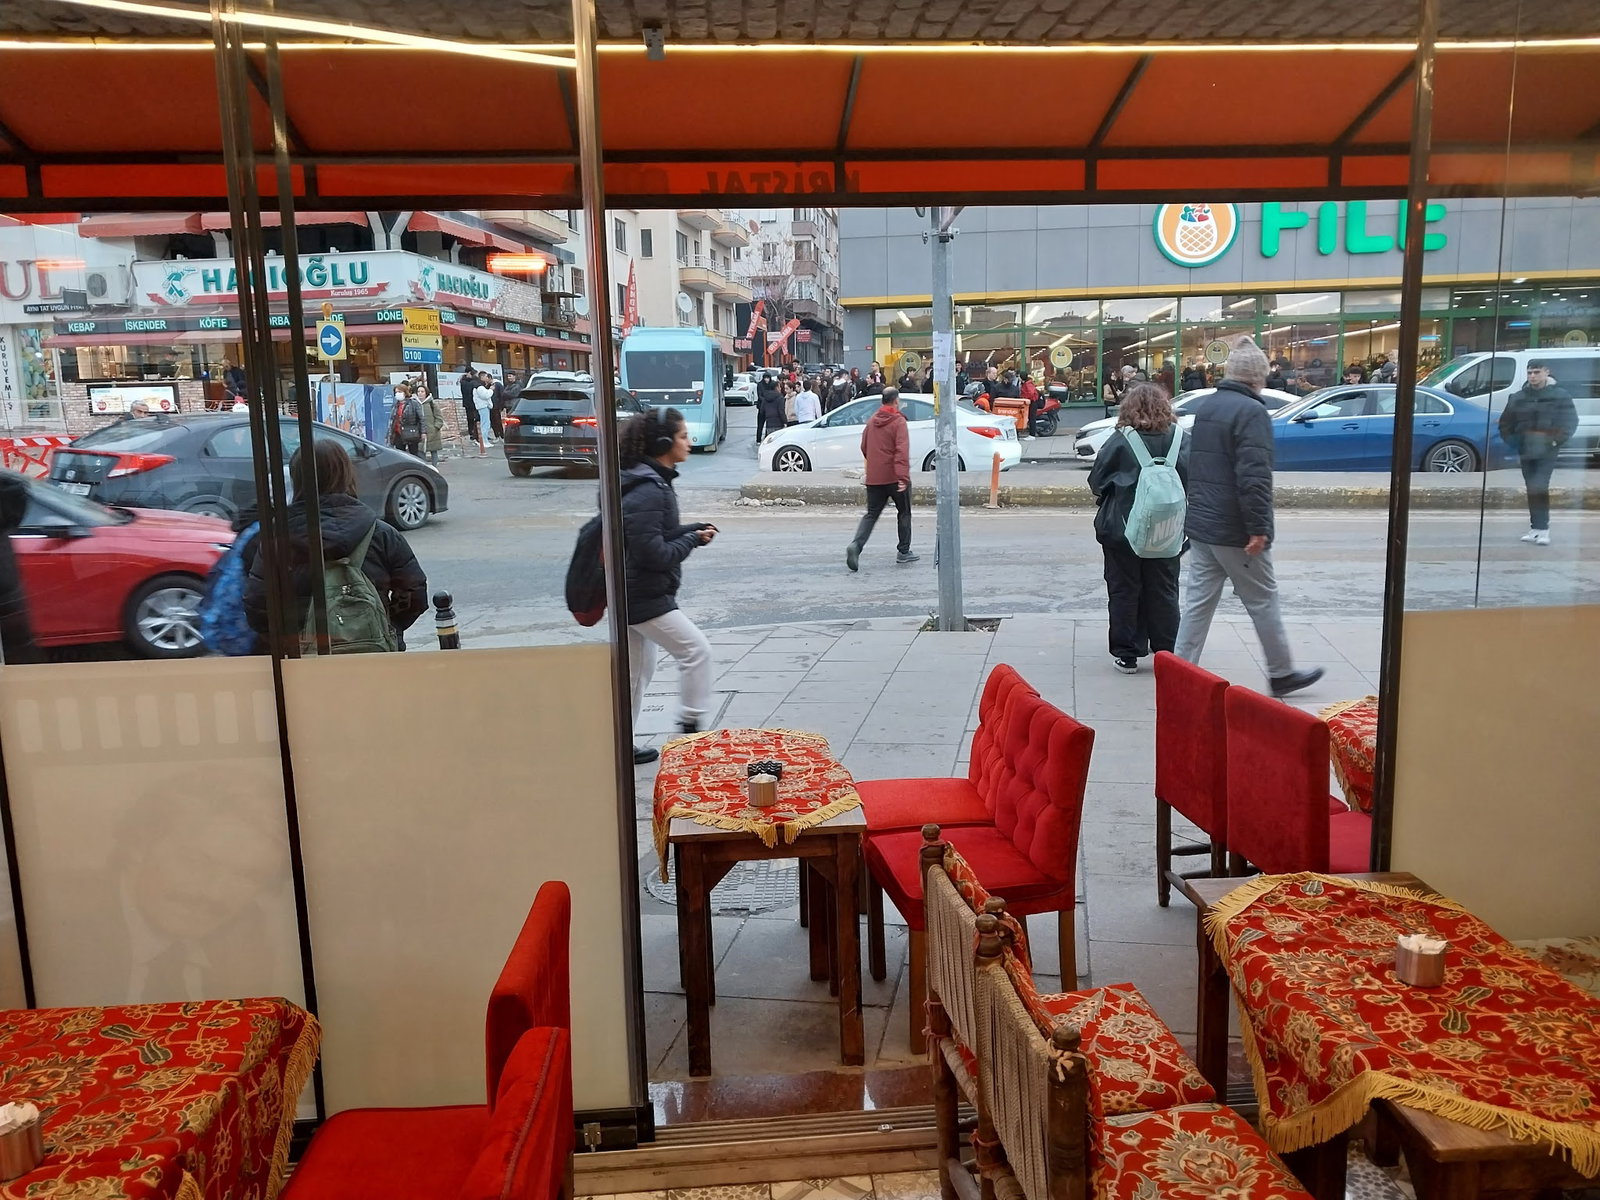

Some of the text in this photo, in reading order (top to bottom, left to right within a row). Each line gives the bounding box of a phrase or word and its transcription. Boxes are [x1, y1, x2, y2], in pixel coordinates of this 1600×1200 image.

[201, 256, 369, 292] HAIĞLU
[354, 288, 369, 296] 1965
[68, 322, 95, 332] KEBAP
[124, 318, 167, 331] İSKENDER
[199, 316, 228, 328] KÖFTE
[404, 336, 419, 344] Kartal
[404, 350, 422, 360] D100
